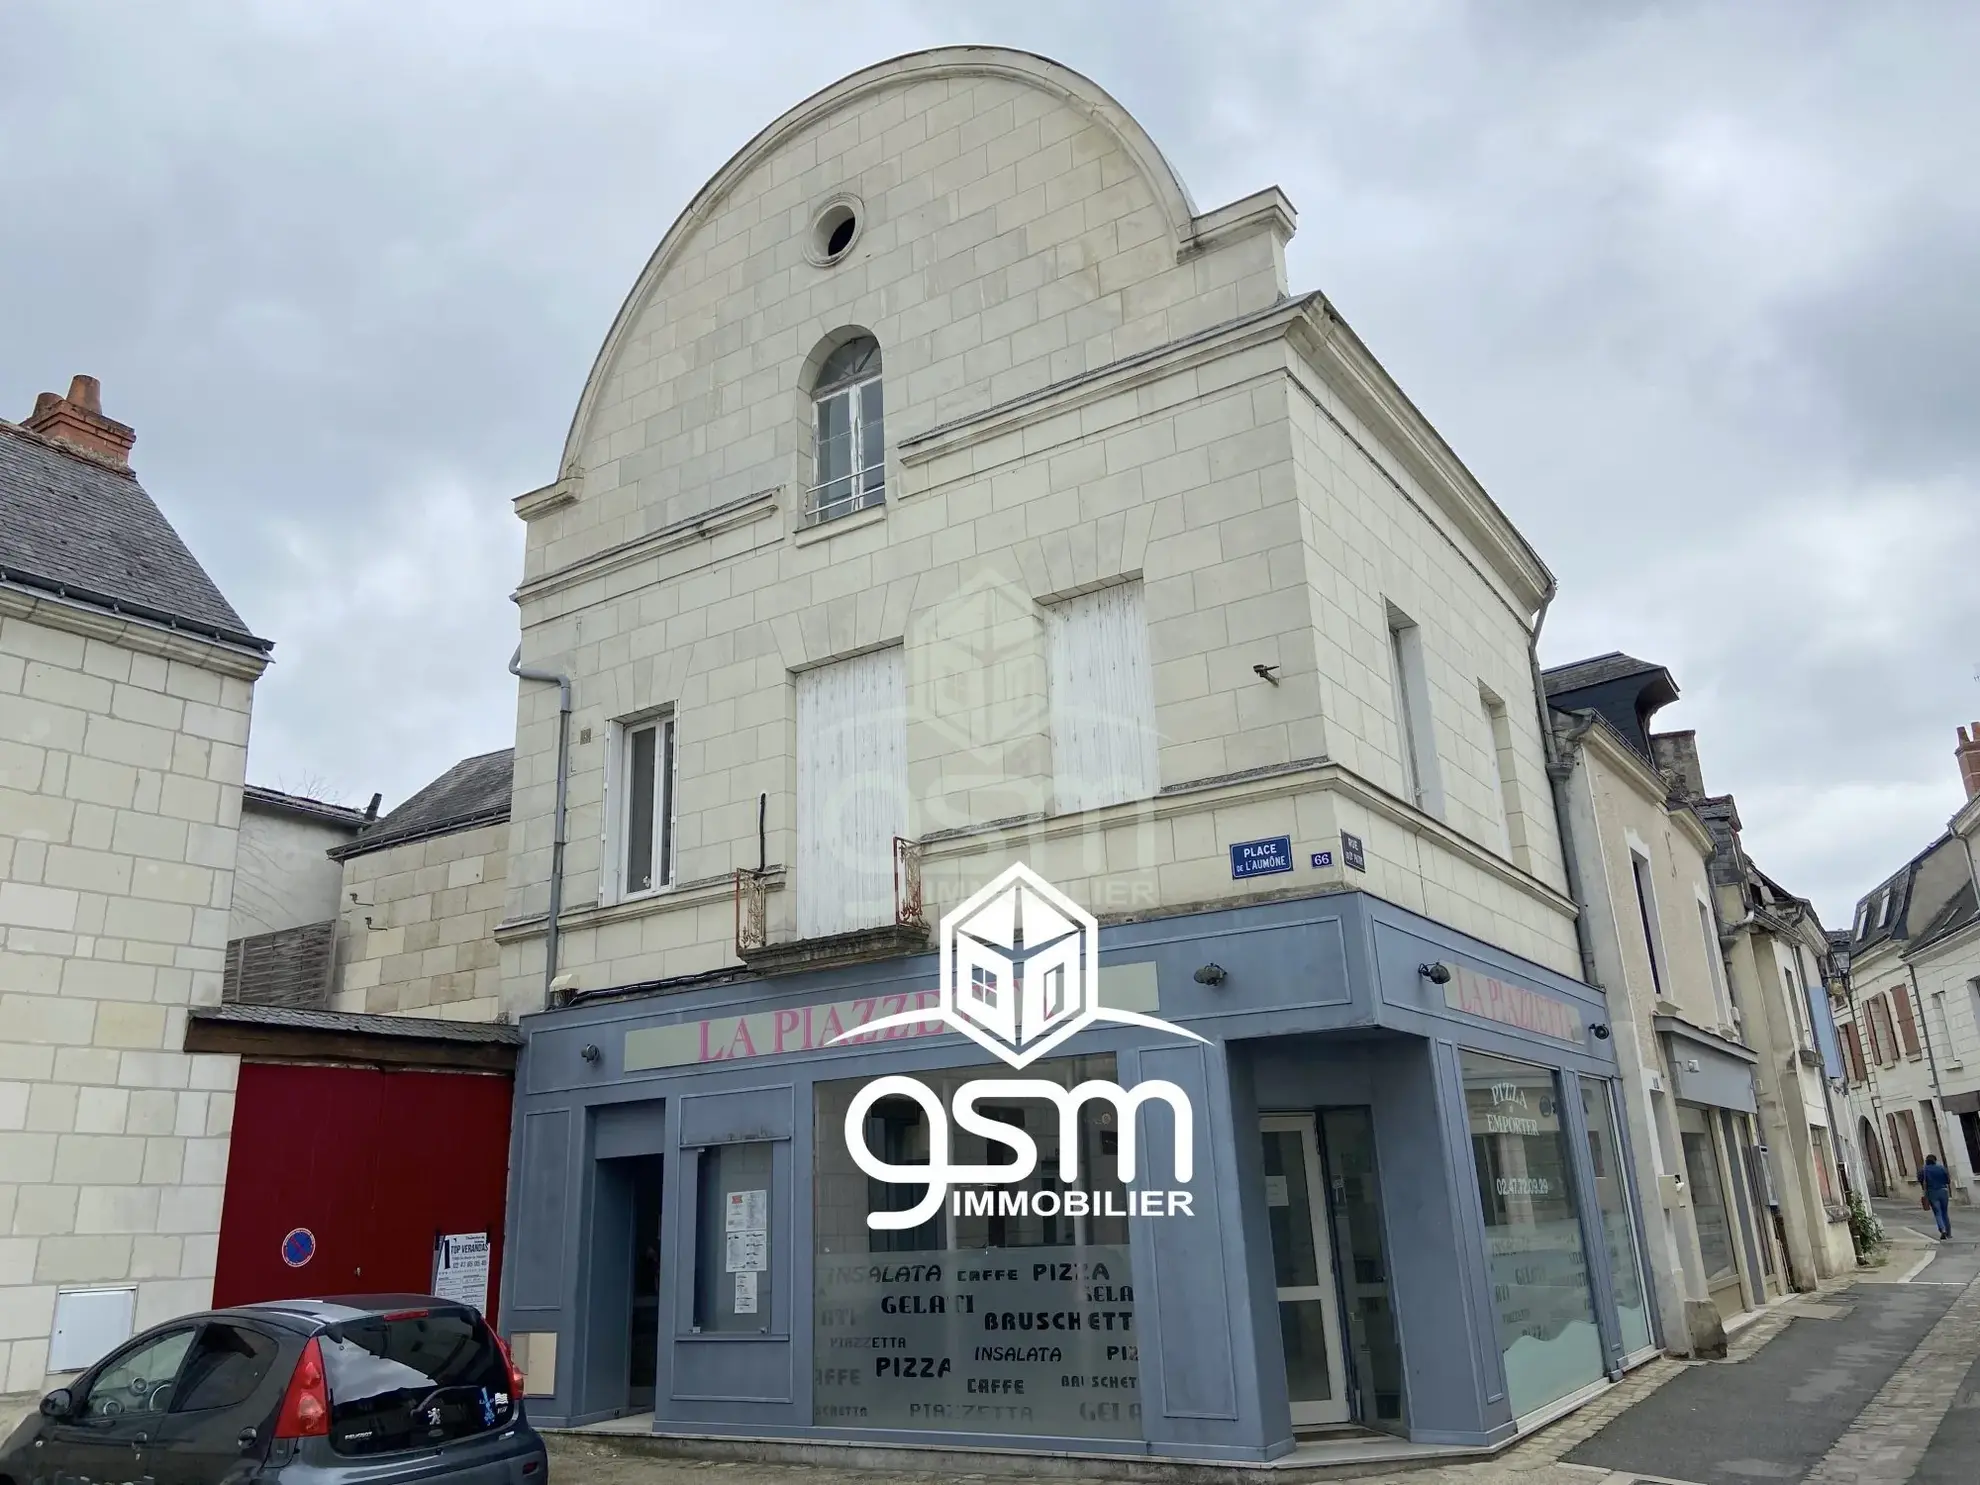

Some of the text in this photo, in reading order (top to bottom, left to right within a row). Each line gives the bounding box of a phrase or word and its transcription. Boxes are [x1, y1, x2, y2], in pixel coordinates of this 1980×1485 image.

[1243, 843, 1277, 858] PLACE
[1314, 853, 1330, 865] 66
[1236, 854, 1287, 872] DE L'AUMÔNE
[1456, 967, 1486, 1018] LA
[699, 1017, 757, 1062] LA
[1491, 1082, 1528, 1110] PIZZA
[1485, 1113, 1540, 1136] EMPORTER
[451, 1245, 461, 1254] TOP
[462, 1243, 489, 1254] VERANDAS
[828, 1263, 942, 1286] INSALATA
[957, 1269, 1018, 1282] CAFFE
[975, 1345, 1062, 1362] INSALATA
[876, 1357, 951, 1379] PIZZA
[967, 1378, 1025, 1395] CAFFE
[909, 1402, 1035, 1423] PIAZETTA
